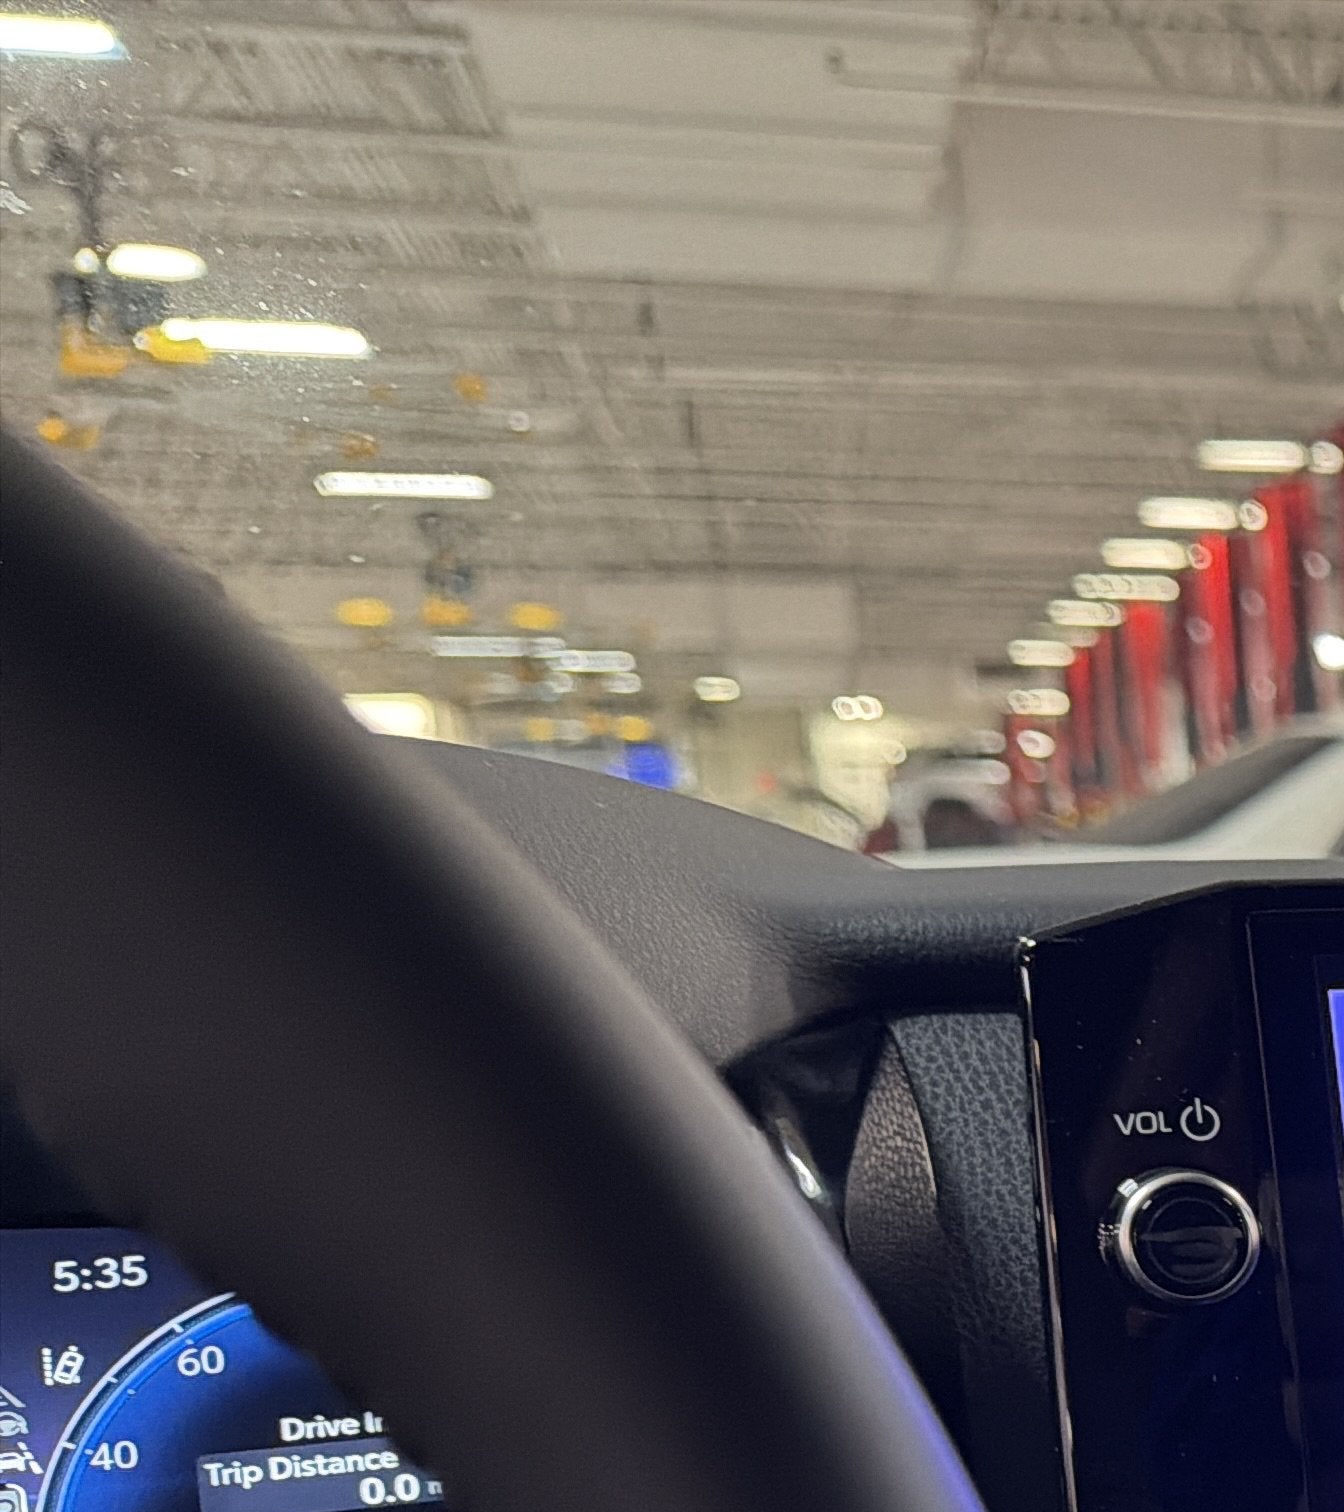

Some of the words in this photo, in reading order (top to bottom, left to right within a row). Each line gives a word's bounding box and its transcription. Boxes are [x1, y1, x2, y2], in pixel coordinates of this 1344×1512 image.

[1113, 1111, 1172, 1136] VOL
[52, 1256, 149, 1292] 5:35
[177, 1345, 226, 1376] 60
[279, 1414, 361, 1442] Drive
[89, 1441, 138, 1471] 40
[203, 1461, 263, 1489] Trip
[269, 1450, 399, 1481] Distance
[359, 1473, 420, 1505] 0.0
